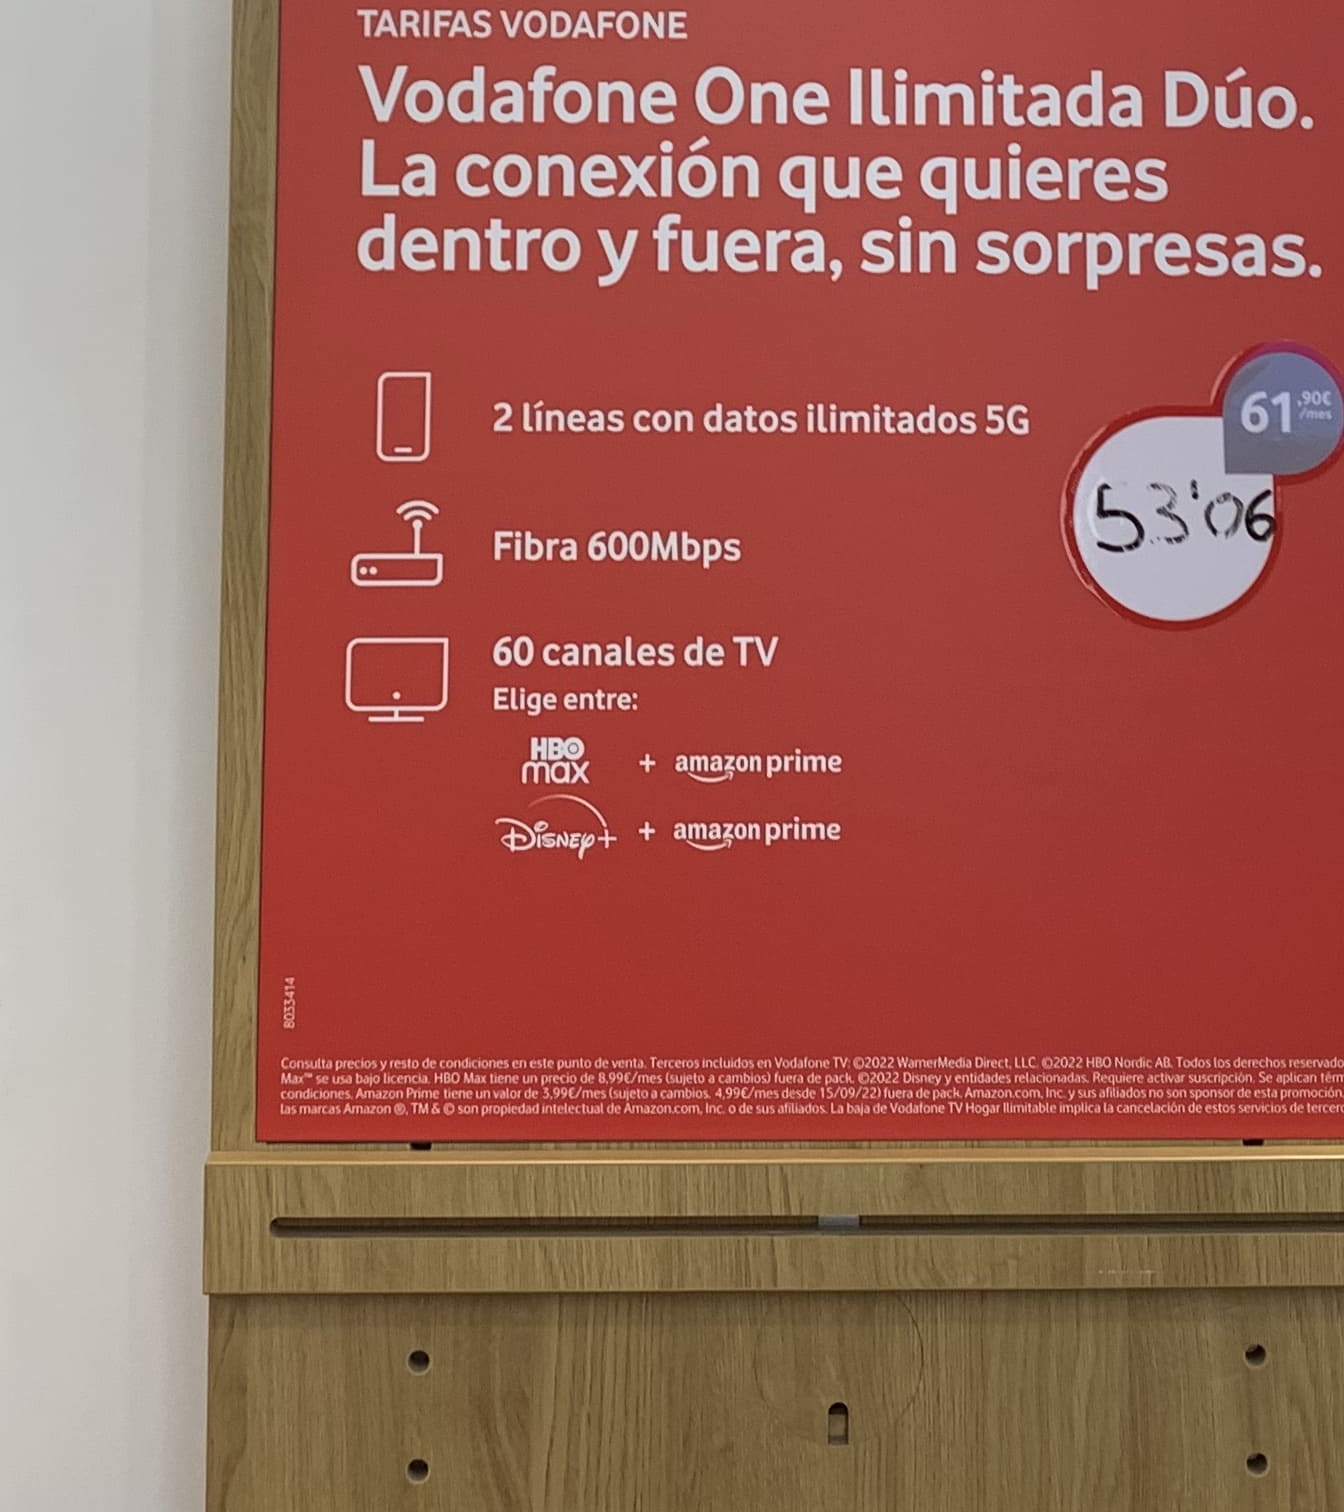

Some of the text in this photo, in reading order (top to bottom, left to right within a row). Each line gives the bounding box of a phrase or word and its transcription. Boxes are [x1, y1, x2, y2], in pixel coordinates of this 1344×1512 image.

[358, 11, 688, 40] TARIFAS VODAFONE
[360, 66, 1314, 130] Vodafone One Ilimitada Dúo.
[362, 136, 1169, 213] La conexión que quieres
[359, 214, 1322, 291] dentro y fuera, sin sorpresas.
[494, 401, 1031, 436] 2 líneas con datos ilimitados 5G
[1241, 391, 1292, 434] 61
[495, 531, 742, 570] Fibra 600Mbps
[493, 636, 780, 668] 60 canales de TV
[494, 688, 639, 717] Elige entre:
[531, 737, 586, 760] HBO
[521, 760, 591, 785] max
[675, 754, 762, 779] amazon
[767, 749, 843, 779] prime
[673, 822, 761, 847] amazon
[766, 817, 842, 847] prime
[280, 1055, 333, 1069] Consulta
[335, 1055, 378, 1072] precios
[379, 1058, 388, 1072] y
[389, 1055, 420, 1069] resto
[421, 1055, 437, 1069] de
[439, 1055, 510, 1069] condiciones
[511, 1058, 527, 1069] en
[529, 1055, 555, 1069] este
[556, 1055, 592, 1072] punto
[594, 1055, 609, 1069] de
[649, 1055, 700, 1069] Terceros
[701, 1055, 755, 1069] incluidos
[756, 1058, 772, 1069] en
[774, 1055, 830, 1069] Vodafone
[1085, 1055, 1112, 1069] HBO
[1114, 1055, 1153, 1069] Nordic
[1175, 1055, 1212, 1069] Todos
[1213, 1055, 1231, 1069] los
[1232, 1055, 1287, 1069] derechos
[315, 1073, 329, 1084] se
[331, 1073, 353, 1084] usa
[355, 1070, 381, 1087] bajo
[434, 1070, 461, 1084] HBO
[463, 1070, 487, 1084] Max
[489, 1070, 520, 1084] tiene
[522, 1073, 538, 1084] un
[540, 1070, 578, 1087] precio
[579, 1070, 595, 1084] de
[665, 1070, 706, 1087] (sujeto
[708, 1073, 716, 1084] a
[718, 1070, 772, 1087] cambios)
[774, 1070, 804, 1084] fuera
[806, 1070, 822, 1084] de
[902, 1070, 942, 1087] Disney
[944, 1073, 952, 1087] y
[954, 1070, 1012, 1084] entidades
[1092, 1070, 1145, 1087] Requiere
[1146, 1070, 1185, 1084] activar
[1258, 1070, 1273, 1084] Se
[1275, 1070, 1318, 1087] aplican
[355, 1085, 404, 1099] Amazon
[406, 1085, 440, 1099] Prime
[443, 1085, 474, 1099] tiene
[475, 1088, 491, 1099] un
[492, 1085, 521, 1099] valor
[523, 1085, 539, 1099] de
[608, 1085, 649, 1102] (sujeto
[650, 1088, 658, 1099] a
[781, 1085, 817, 1099] desde
[883, 1085, 914, 1099] fuera
[915, 1085, 931, 1099] de
[1068, 1088, 1076, 1102] y
[1077, 1088, 1097, 1099] sus
[1098, 1085, 1147, 1099] afiliados
[1148, 1088, 1164, 1099] no
[1166, 1088, 1187, 1099] son
[1189, 1088, 1235, 1102] sponsor
[1236, 1085, 1252, 1099] de
[1253, 1085, 1278, 1099] esta
